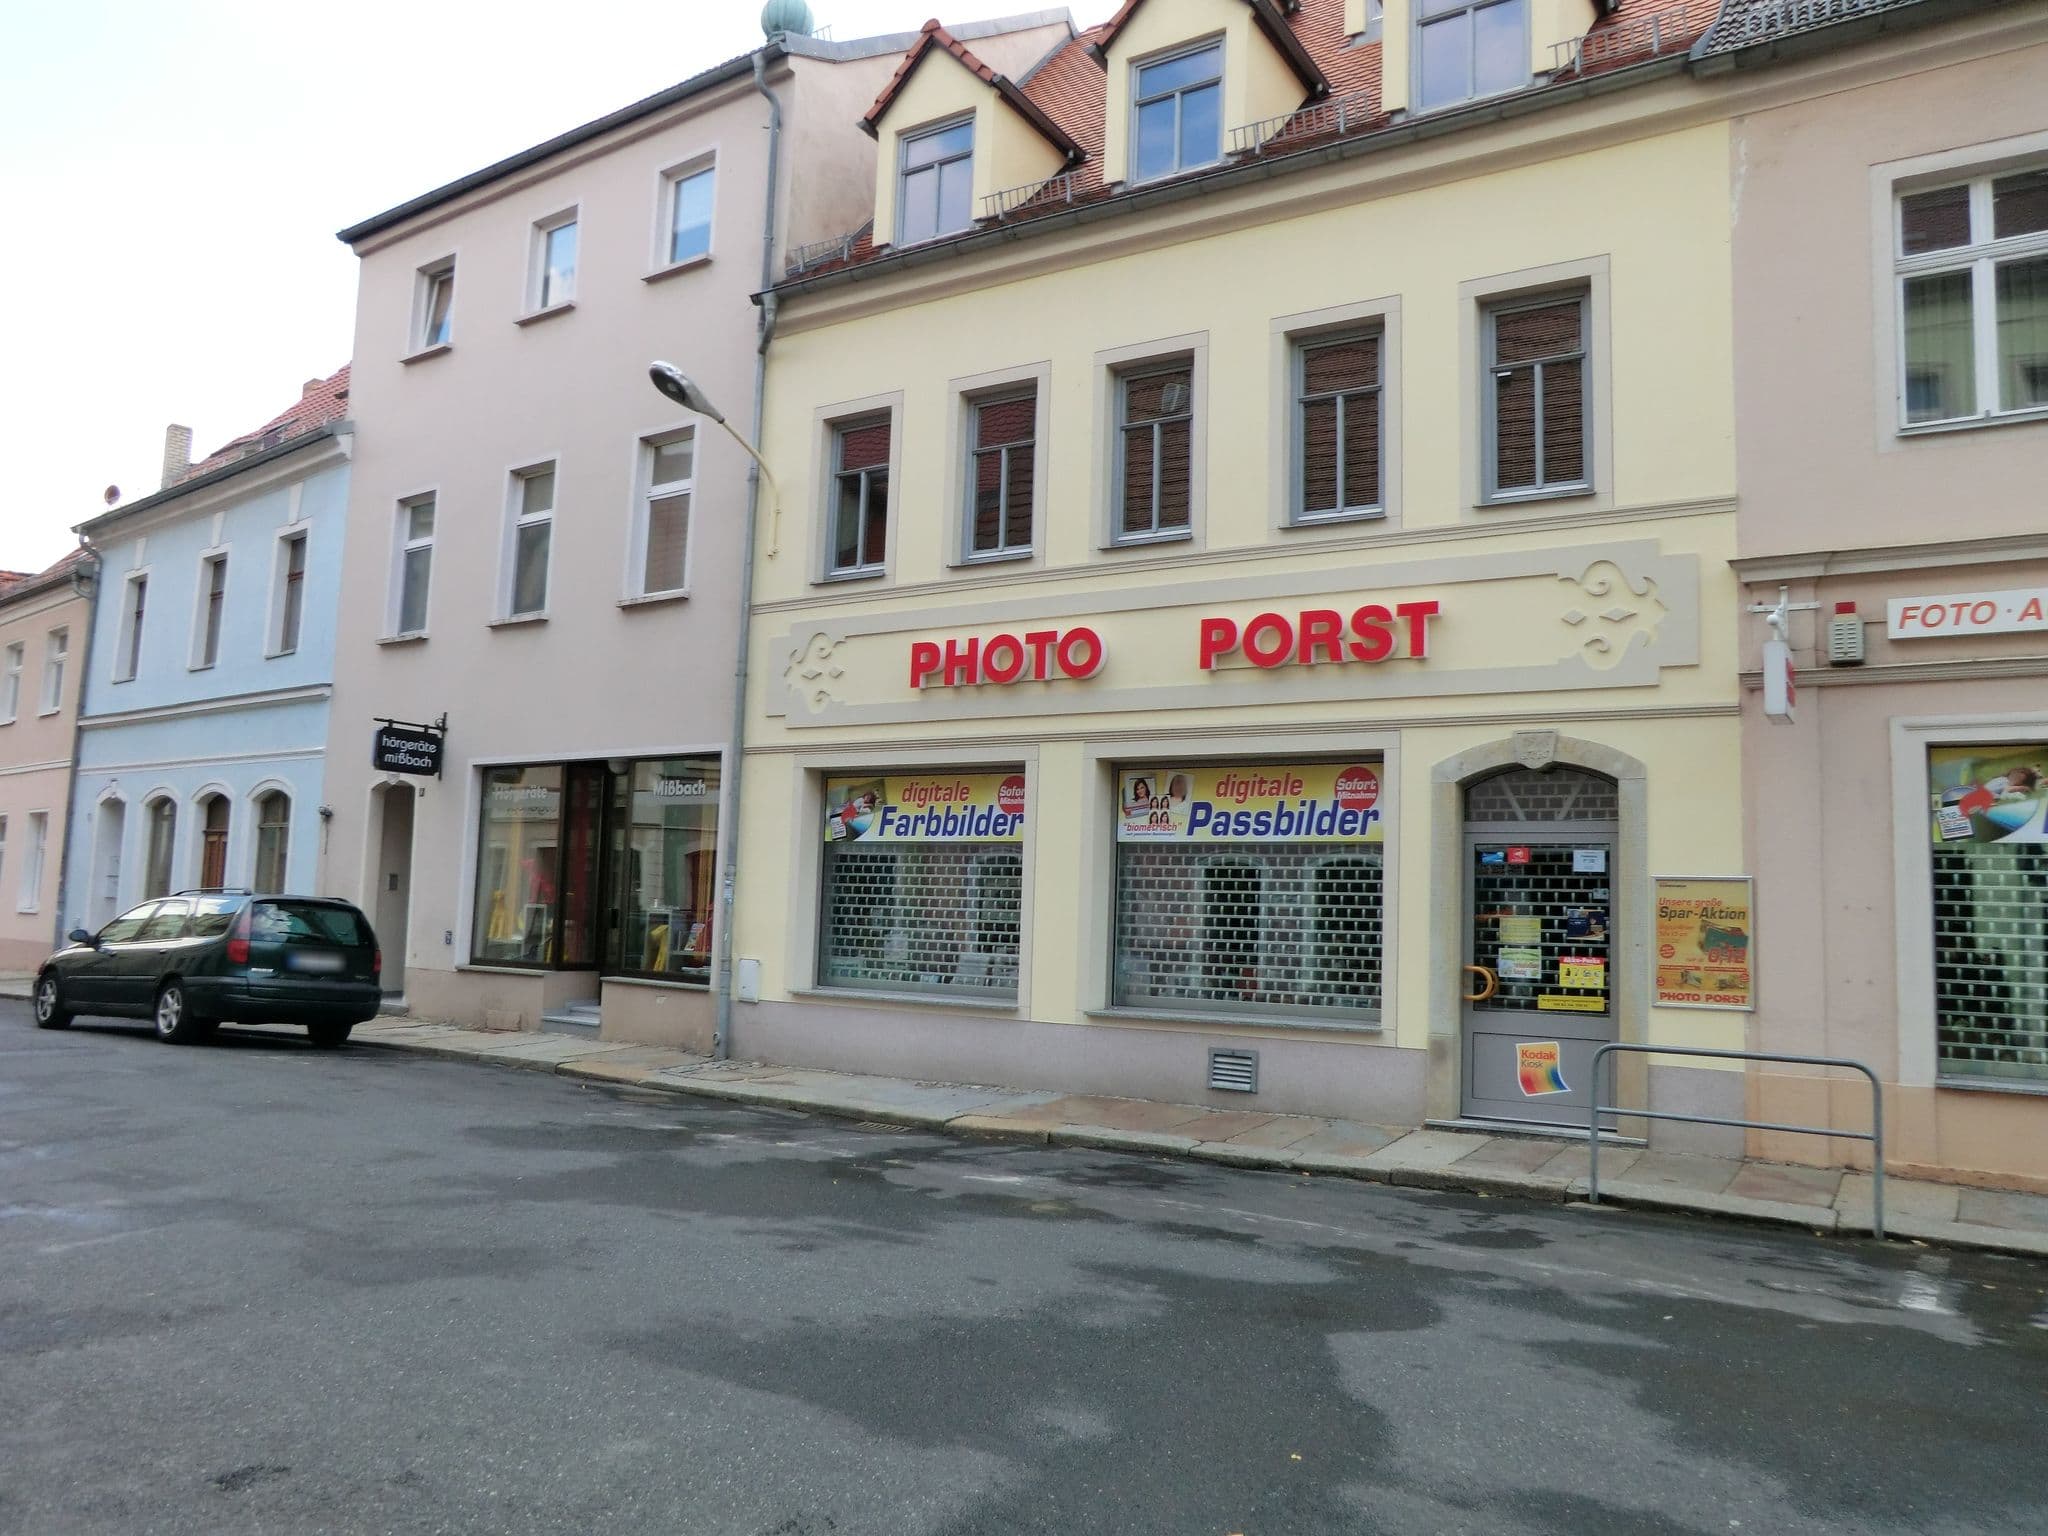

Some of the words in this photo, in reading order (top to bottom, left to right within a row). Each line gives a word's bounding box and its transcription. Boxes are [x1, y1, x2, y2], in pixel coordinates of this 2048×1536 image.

[1899, 600, 1997, 629] FOTO
[2017, 597, 2048, 622] A
[910, 627, 1105, 689] PHOTO
[1200, 600, 1440, 670] PORST
[382, 735, 437, 753] hörgeräte
[384, 753, 432, 767] mißbach
[654, 779, 706, 796] Mißbach
[1000, 785, 1025, 797] Sofor
[1215, 773, 1304, 804] digitale
[1336, 778, 1377, 790] Sofort
[902, 781, 971, 808] digitale
[878, 805, 1024, 836] Farbbilder
[1187, 799, 1380, 836] Passbilder
[1659, 906, 1746, 921] Spar-Aktion
[1660, 992, 1701, 1002] PHOTO
[1705, 994, 1747, 1004] PORST
[1521, 1050, 1556, 1061] Kodak
